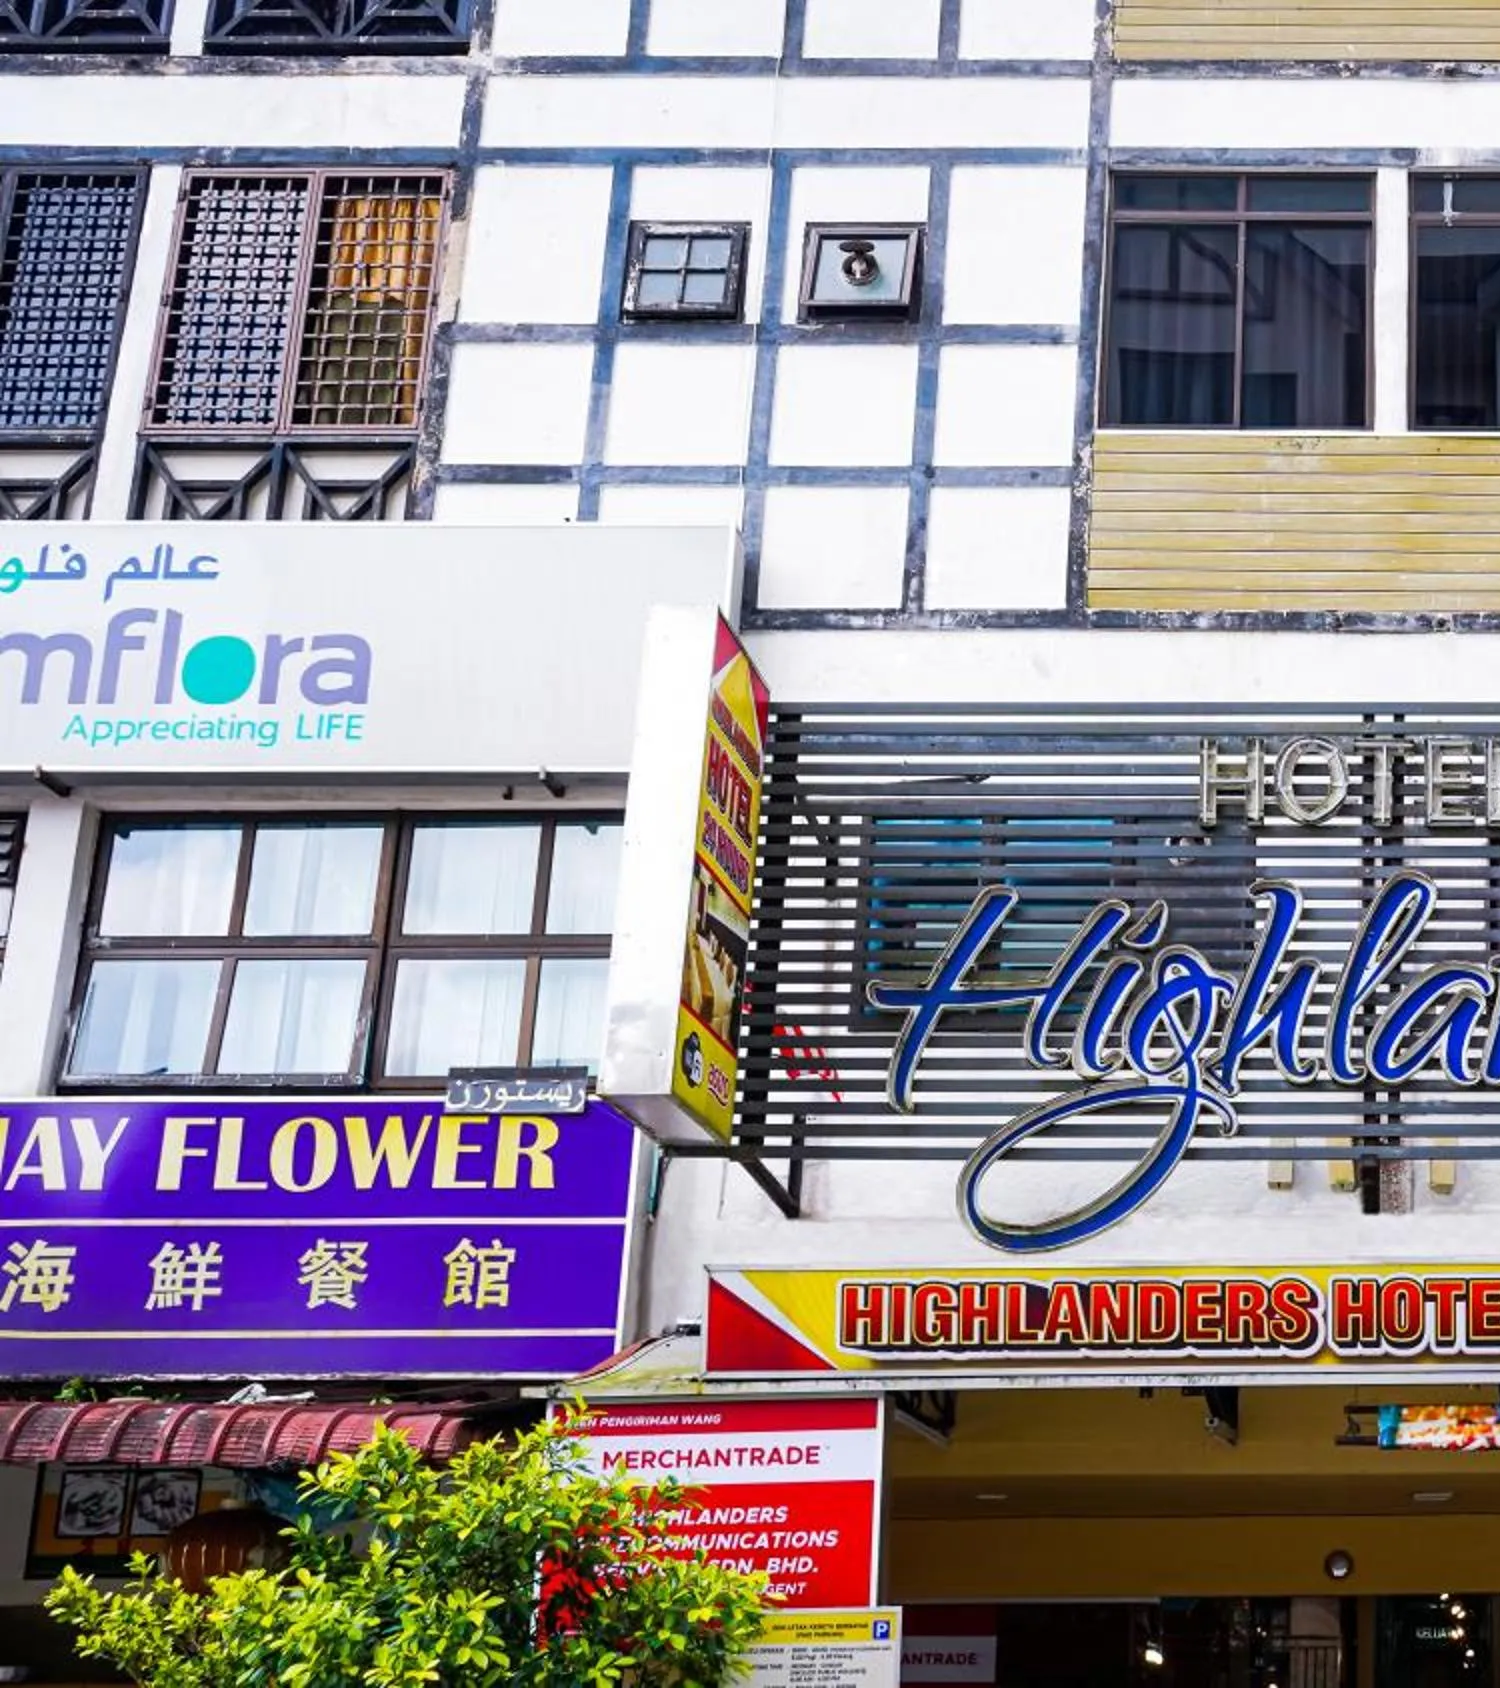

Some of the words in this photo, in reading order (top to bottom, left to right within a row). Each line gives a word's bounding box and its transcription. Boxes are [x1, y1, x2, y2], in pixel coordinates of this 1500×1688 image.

[103, 543, 220, 604] عالم
[62, 713, 280, 748] Appreciating
[296, 713, 367, 741] LIFE
[0, 1116, 131, 1191] AY
[155, 1114, 561, 1192] FLOWER
[0, 1237, 517, 1313] 海鮮餐館
[840, 1279, 1316, 1347] HIGHLANDERS
[682, 1413, 722, 1425] WANG
[601, 1445, 821, 1471] MERCHANTRADE
[765, 1556, 819, 1574] BHD.
[755, 1582, 807, 1596] GENT
